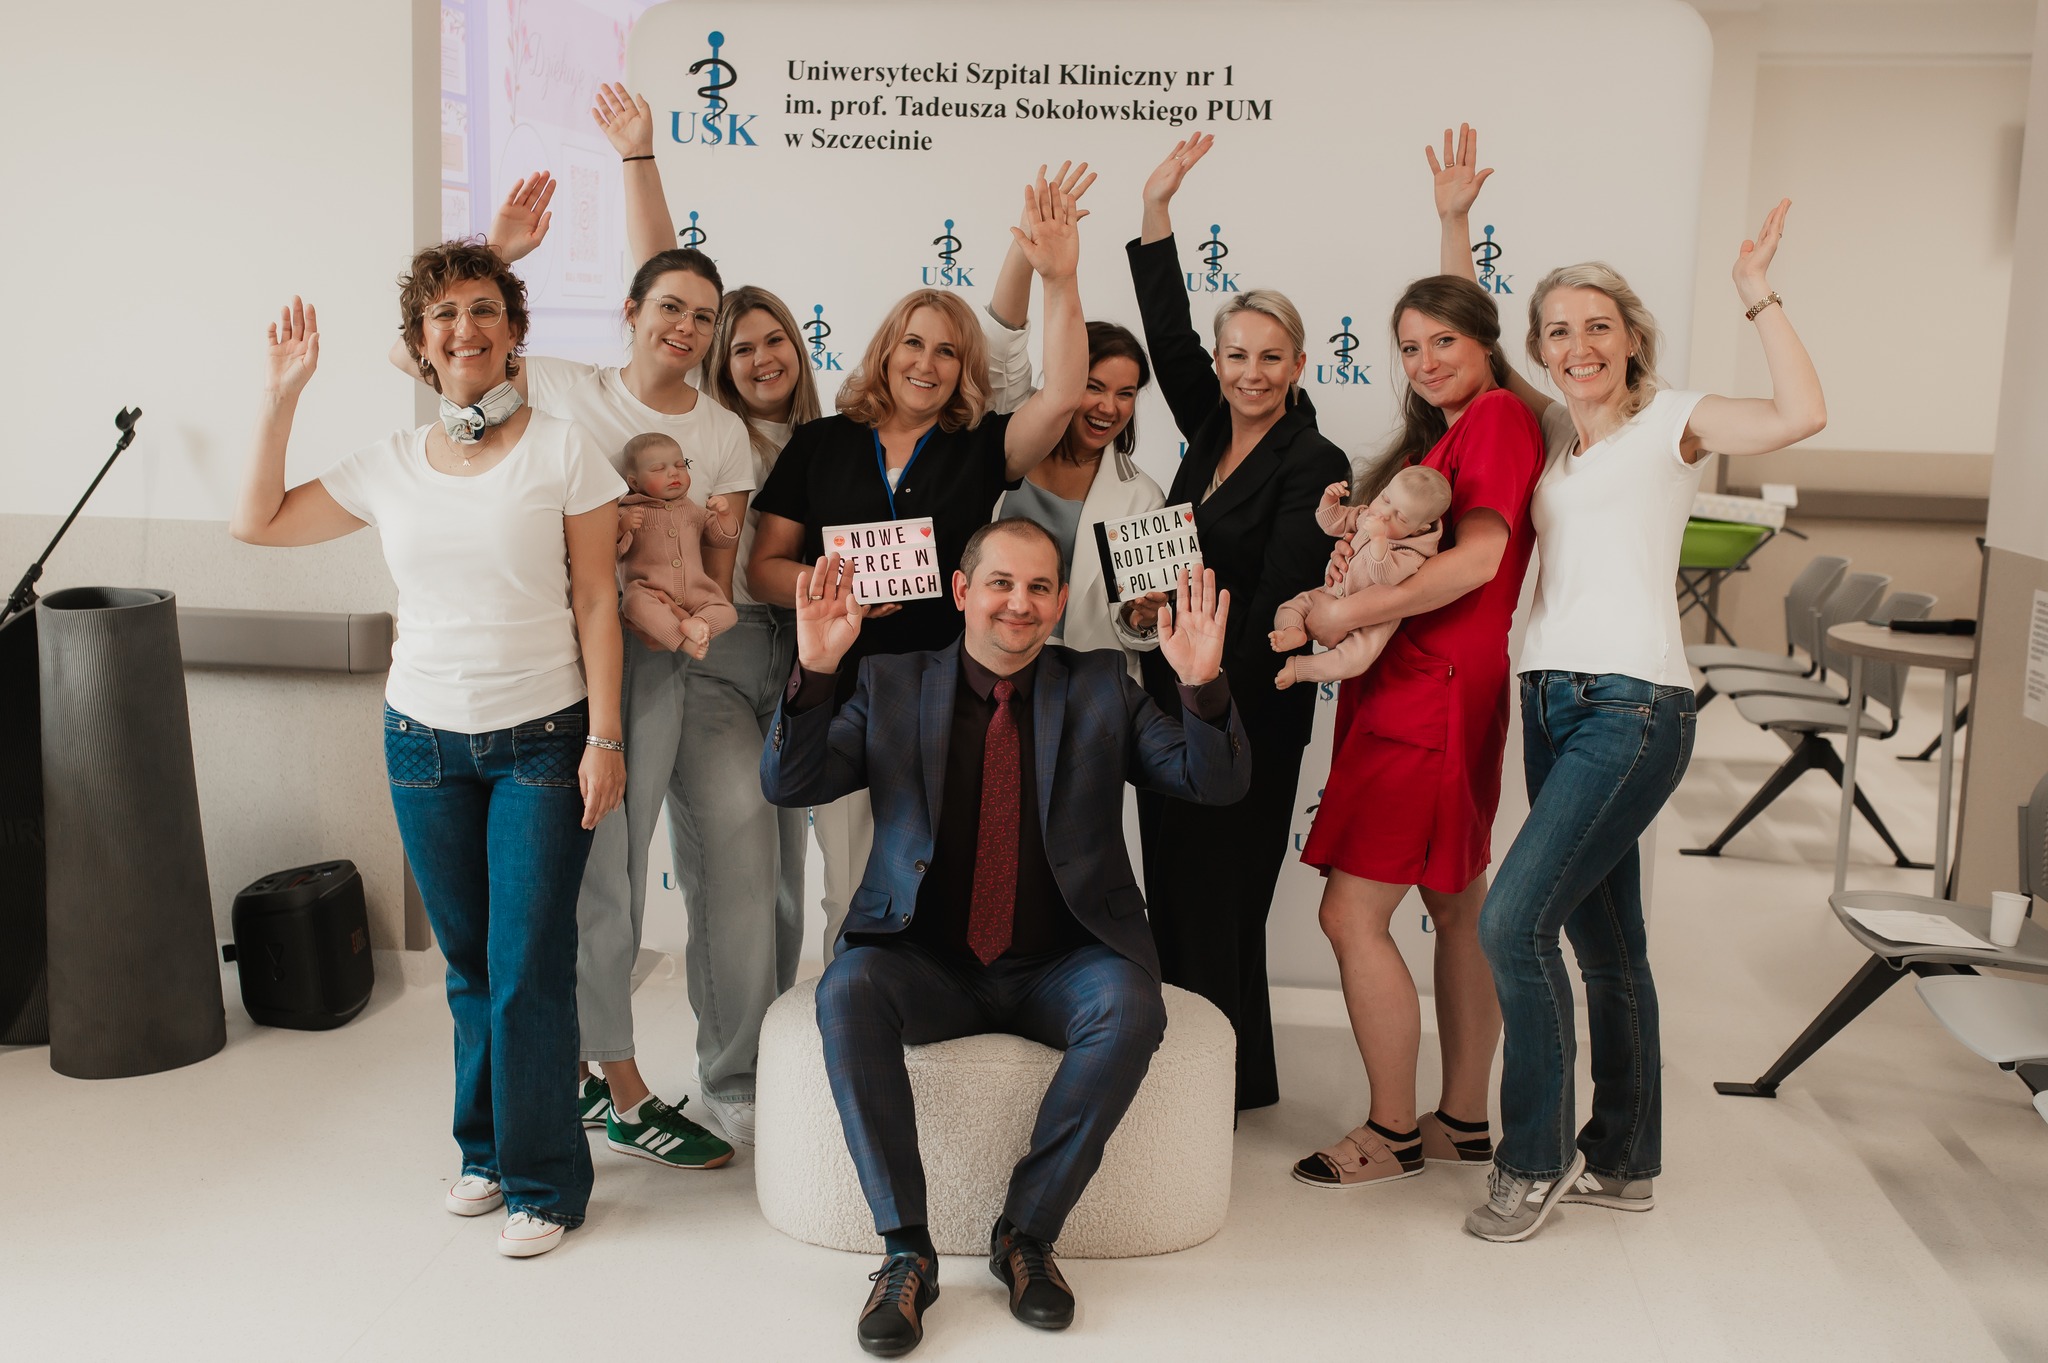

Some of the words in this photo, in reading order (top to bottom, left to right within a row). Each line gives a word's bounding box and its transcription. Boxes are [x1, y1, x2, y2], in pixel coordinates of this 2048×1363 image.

[787, 60, 958, 88] Uniwersytecki
[966, 62, 1051, 90] Szpital
[1058, 64, 1178, 92] Kliniczny
[1186, 70, 1215, 86] nr
[1224, 64, 1234, 87] 1
[785, 93, 822, 115] im.
[830, 95, 887, 121] prof.
[895, 95, 1007, 118] Tadeusza
[1015, 97, 1198, 127] Sokołowskiego
[1207, 99, 1273, 121] PUM
[668, 110, 760, 147] USK
[784, 133, 804, 148] w
[811, 127, 933, 151] Szczecinie
[921, 266, 976, 287] USK
[1186, 272, 1242, 293] USK
[1478, 274, 1516, 295] SK
[810, 351, 844, 371] SK
[1316, 364, 1373, 385] USK
[850, 526, 906, 549] NOWE
[1120, 510, 1183, 543] SZKOLA
[914, 548, 930, 567] W
[1113, 535, 1198, 570] RODZENIA
[852, 574, 938, 599] LICACH
